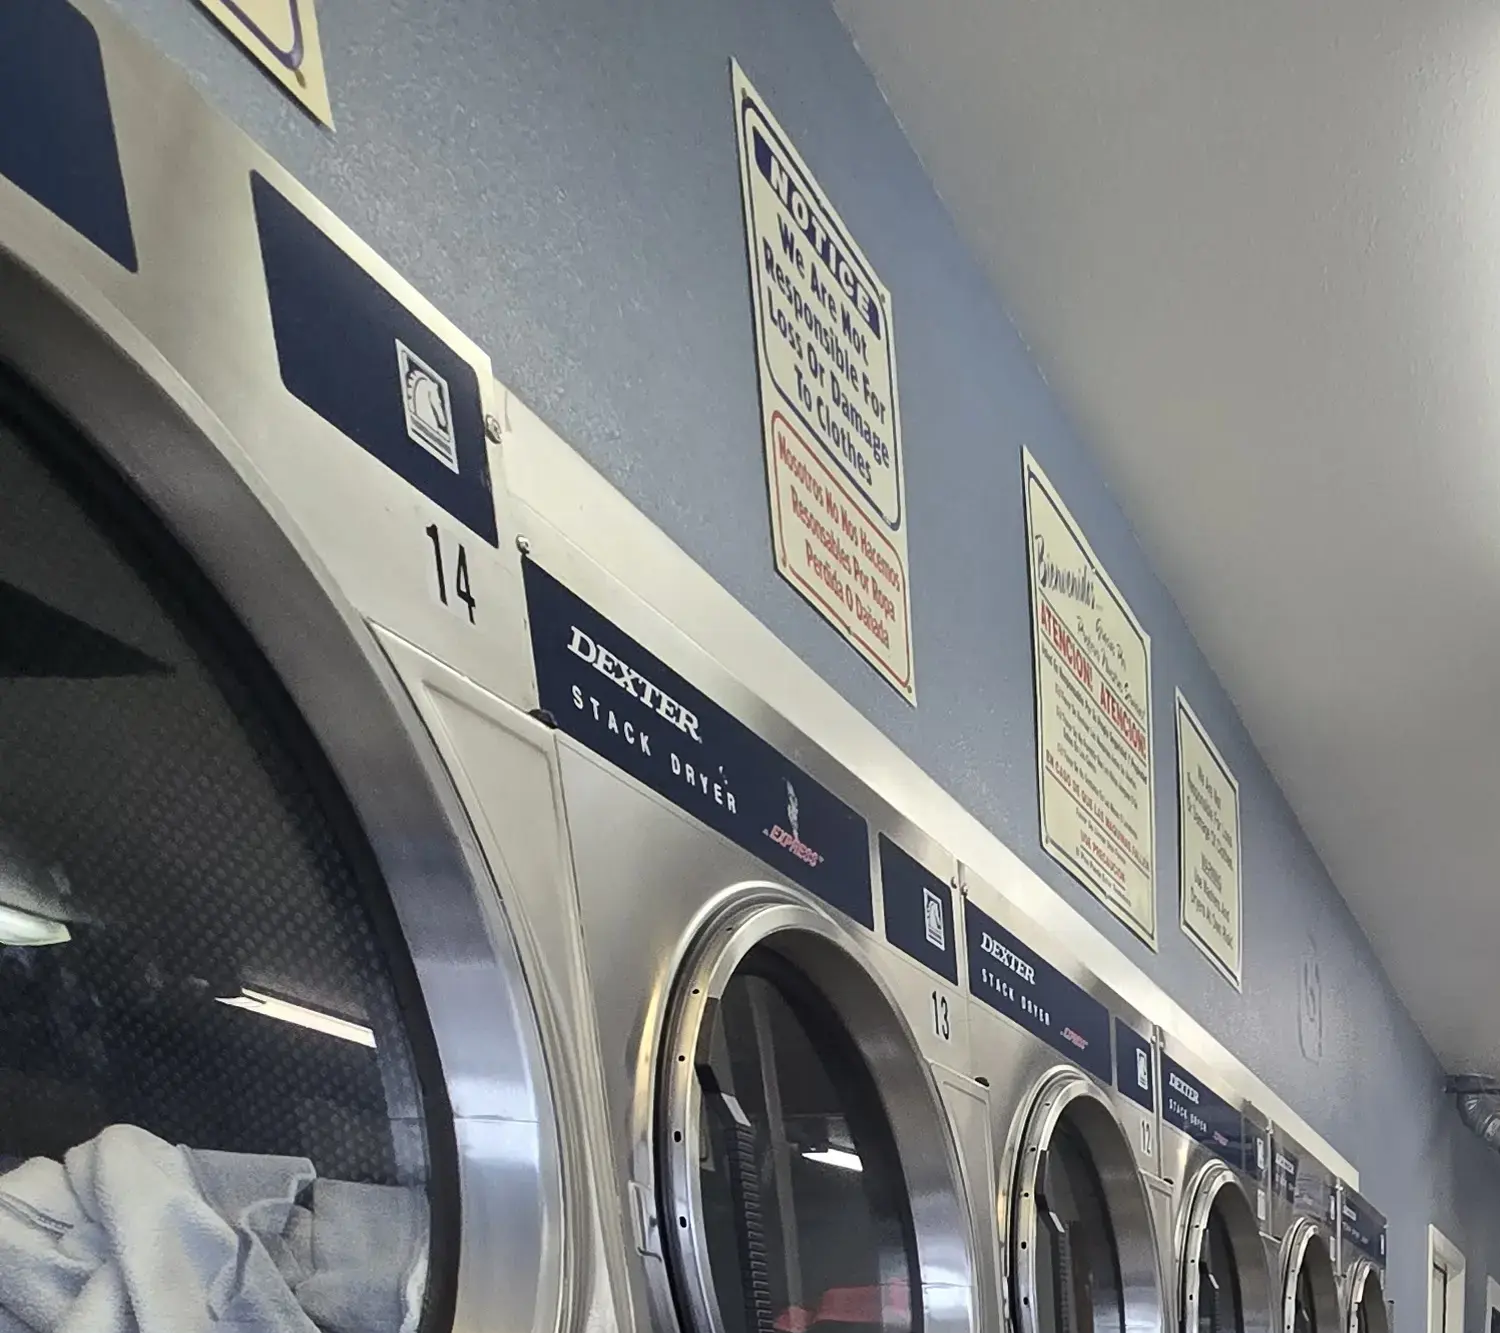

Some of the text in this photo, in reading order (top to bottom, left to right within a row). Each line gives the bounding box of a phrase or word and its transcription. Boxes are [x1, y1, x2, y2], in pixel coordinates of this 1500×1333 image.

[770, 158, 869, 319] NOTICE
[776, 213, 868, 365] We Are Not
[762, 239, 885, 424] Responsible For
[767, 286, 889, 467] Loss Or Damage
[793, 364, 872, 485] To Clothes
[777, 432, 900, 591] Nosotros No Nos Hacemos
[425, 523, 475, 624] 14
[804, 539, 844, 602] Perdida
[844, 583, 854, 612] O
[851, 555, 869, 593] Por
[870, 575, 895, 621] Ropa
[567, 625, 702, 742] DEXTER
[1040, 602, 1093, 690] ATENCION!
[1099, 683, 1146, 758] ATENCION!
[571, 685, 737, 814] STACK DRYER
[769, 824, 820, 867] EXPRESS
[932, 990, 950, 1040] 13
[980, 932, 1035, 985] DEXTER
[981, 968, 1050, 1026] STACK DRYER
[1169, 1072, 1199, 1104] DEXTER
